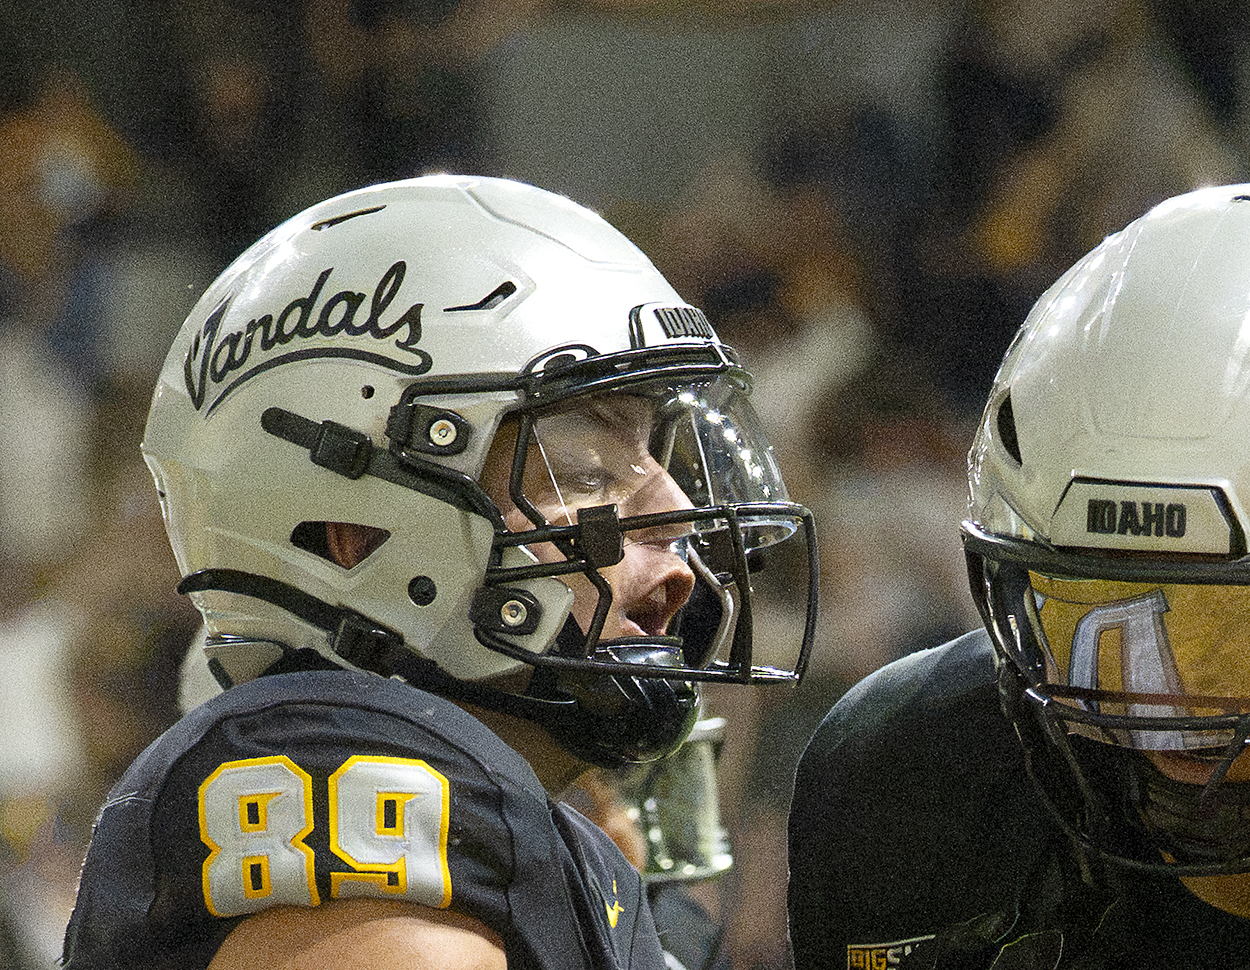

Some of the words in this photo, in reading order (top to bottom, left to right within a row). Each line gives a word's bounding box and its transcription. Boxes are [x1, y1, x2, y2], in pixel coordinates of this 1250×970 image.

[184, 261, 433, 412] Vandals
[1087, 499, 1186, 538] IDAHO
[198, 754, 452, 918] 89
